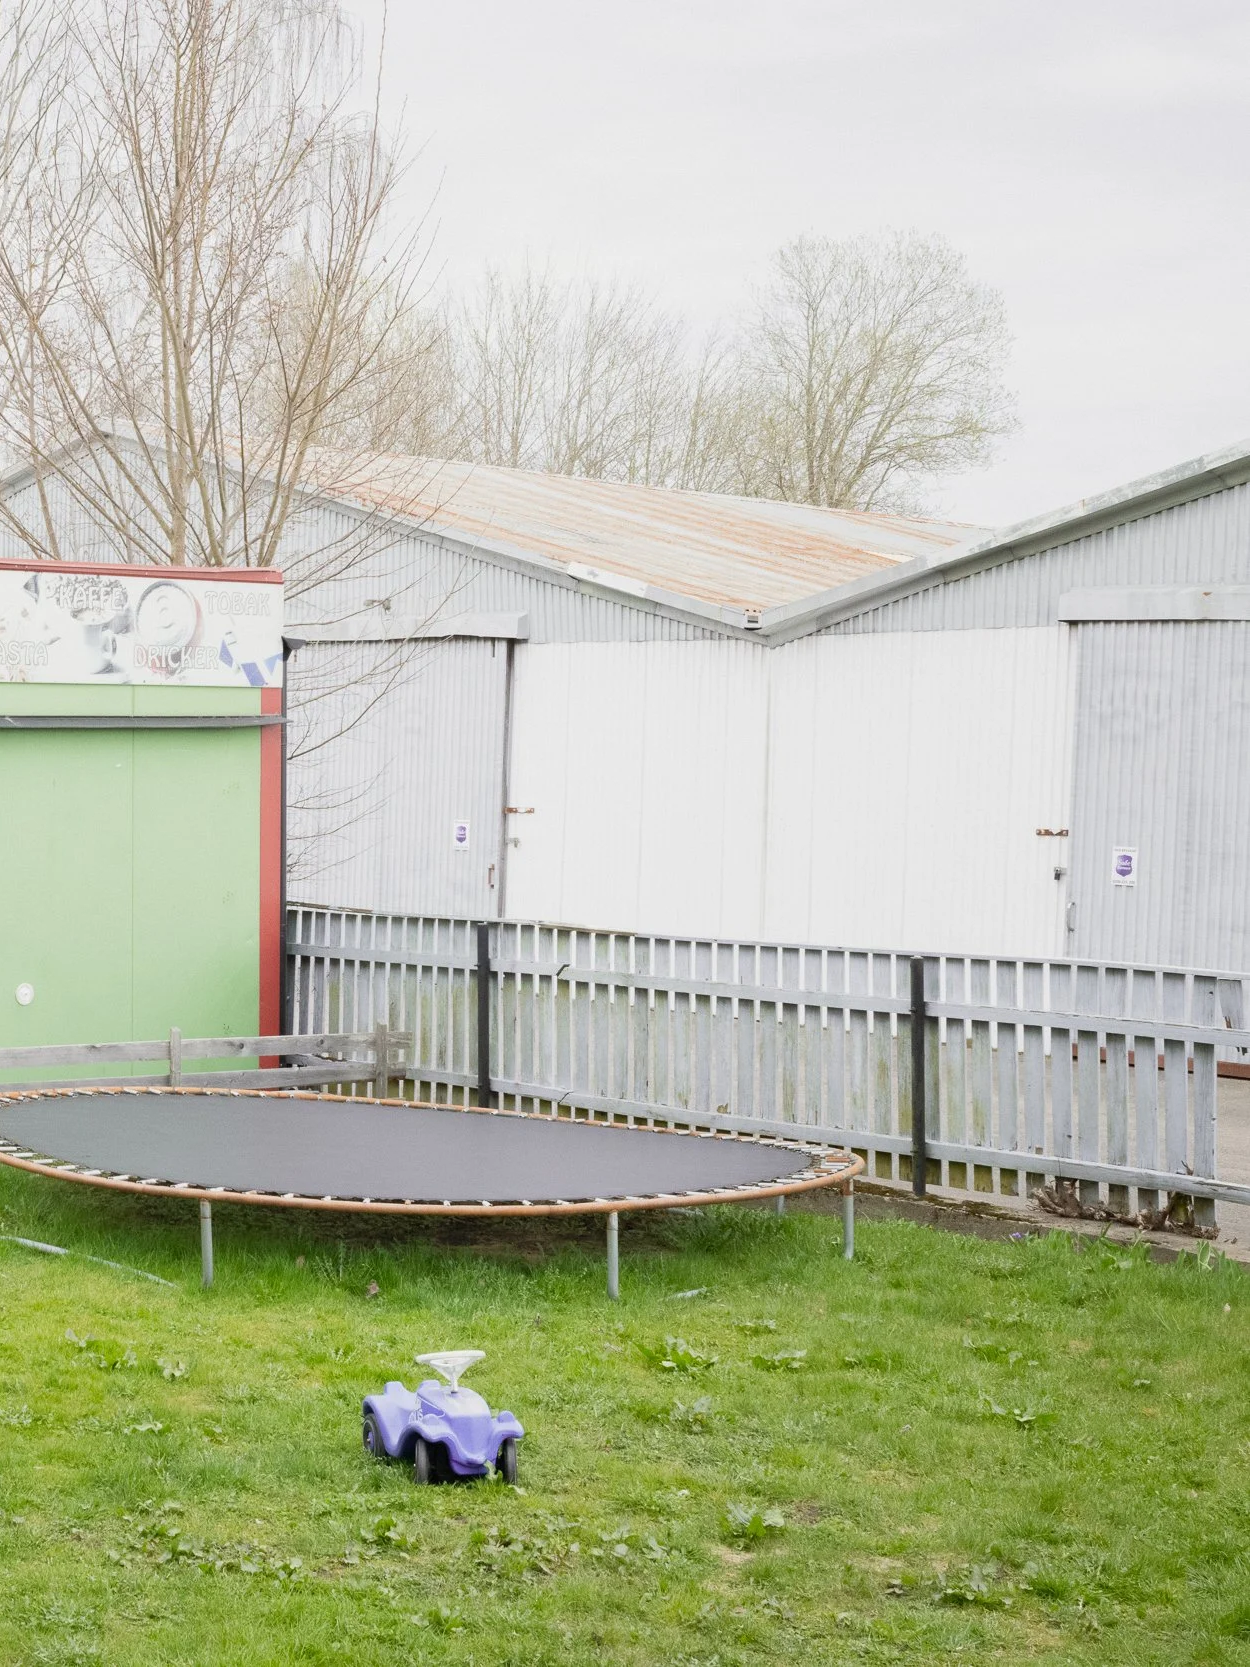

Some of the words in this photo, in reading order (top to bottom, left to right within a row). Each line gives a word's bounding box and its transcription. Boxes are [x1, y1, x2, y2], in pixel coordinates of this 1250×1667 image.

[57, 583, 124, 611] KAFFE
[204, 590, 271, 616] TOBAK
[133, 644, 220, 670] DRICKER
